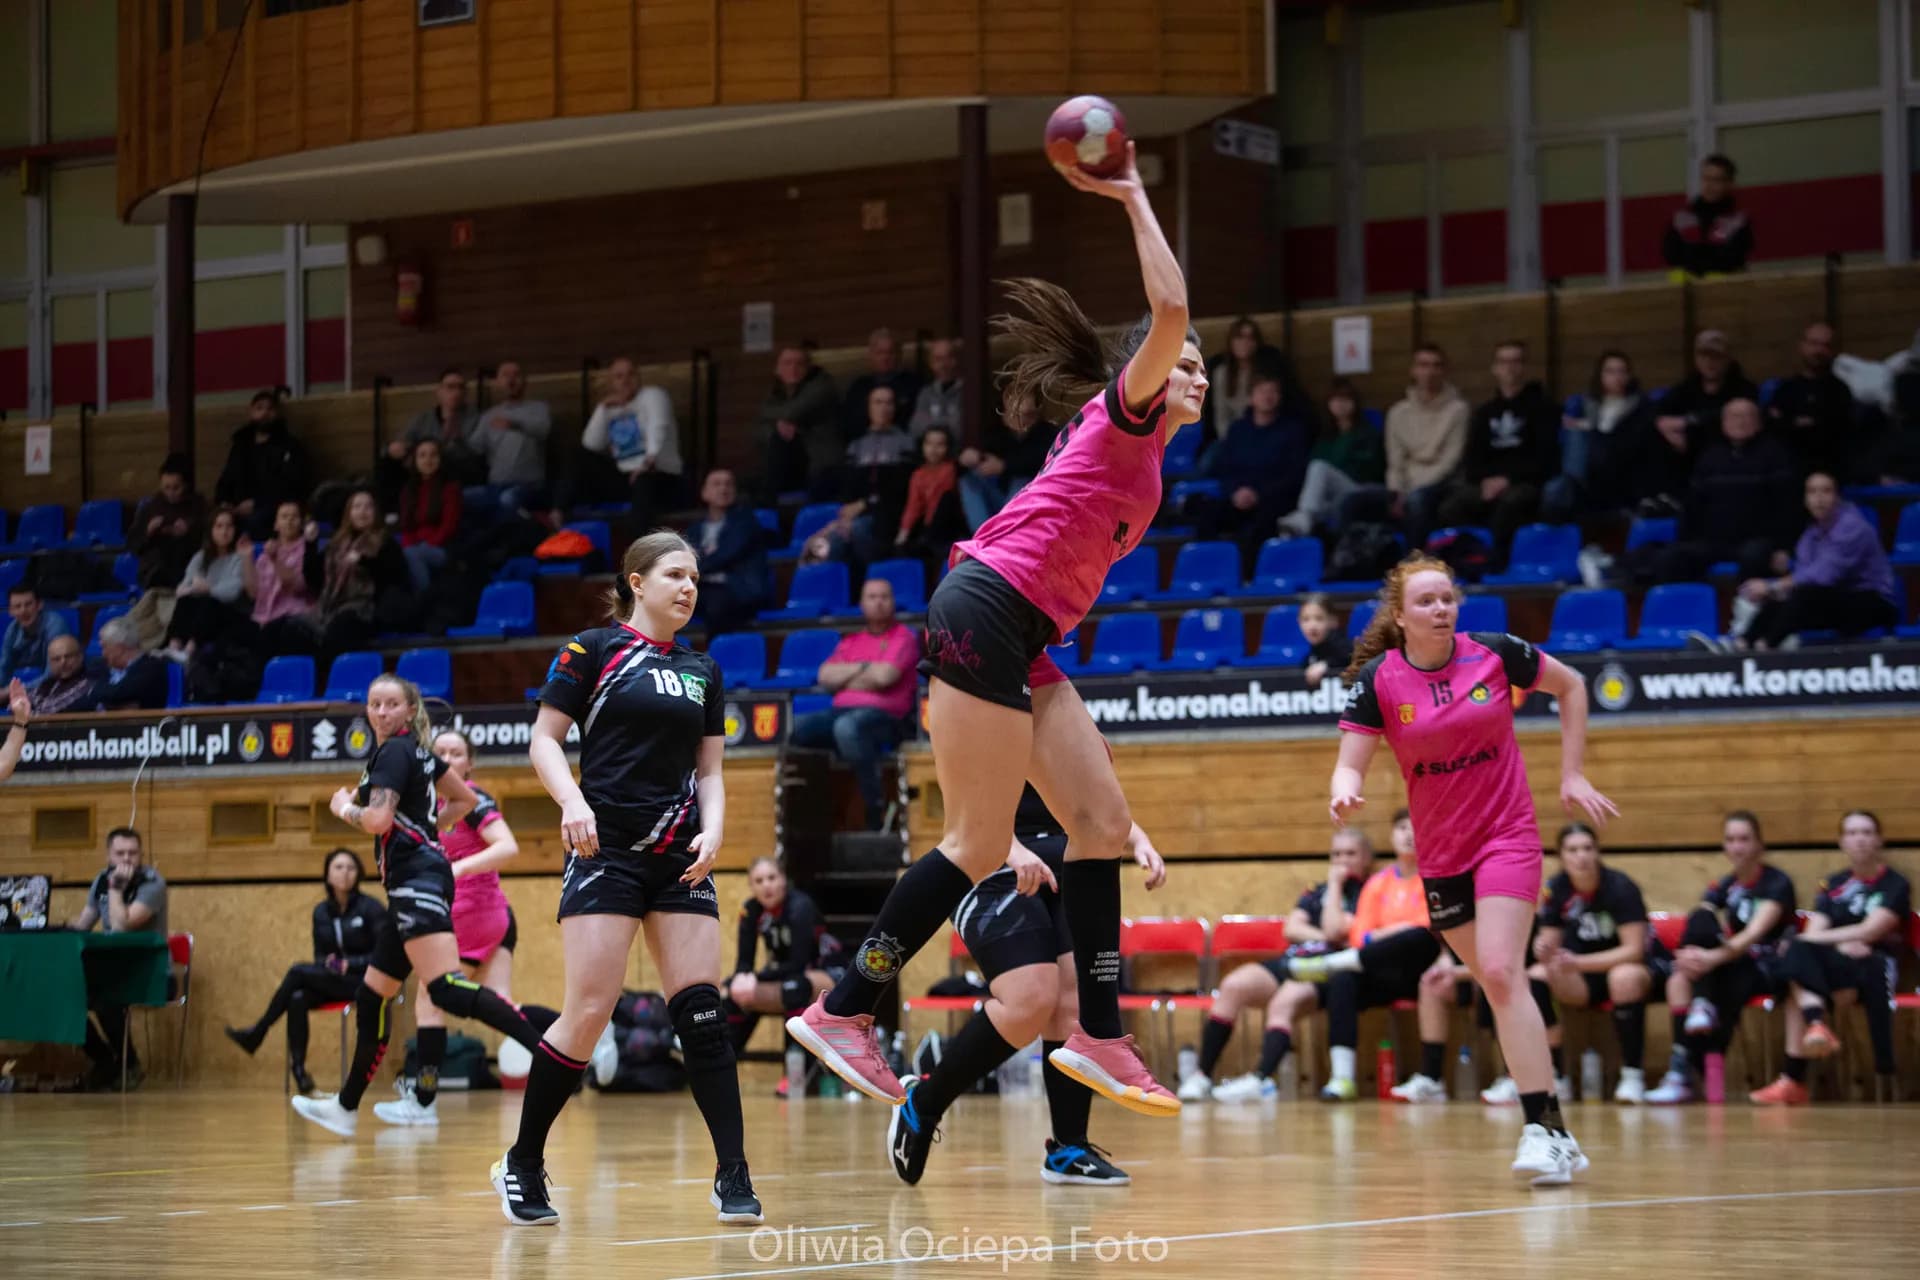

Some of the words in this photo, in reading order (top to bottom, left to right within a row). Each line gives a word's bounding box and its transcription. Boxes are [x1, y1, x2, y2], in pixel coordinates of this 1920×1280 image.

[648, 668, 683, 696] 18
[1640, 653, 1920, 699] www.koronaha
[1427, 680, 1454, 707] 15
[16, 723, 231, 765] oronahandball.pl
[1429, 746, 1498, 775] SUZUKI
[693, 1009, 717, 1022] SELECT
